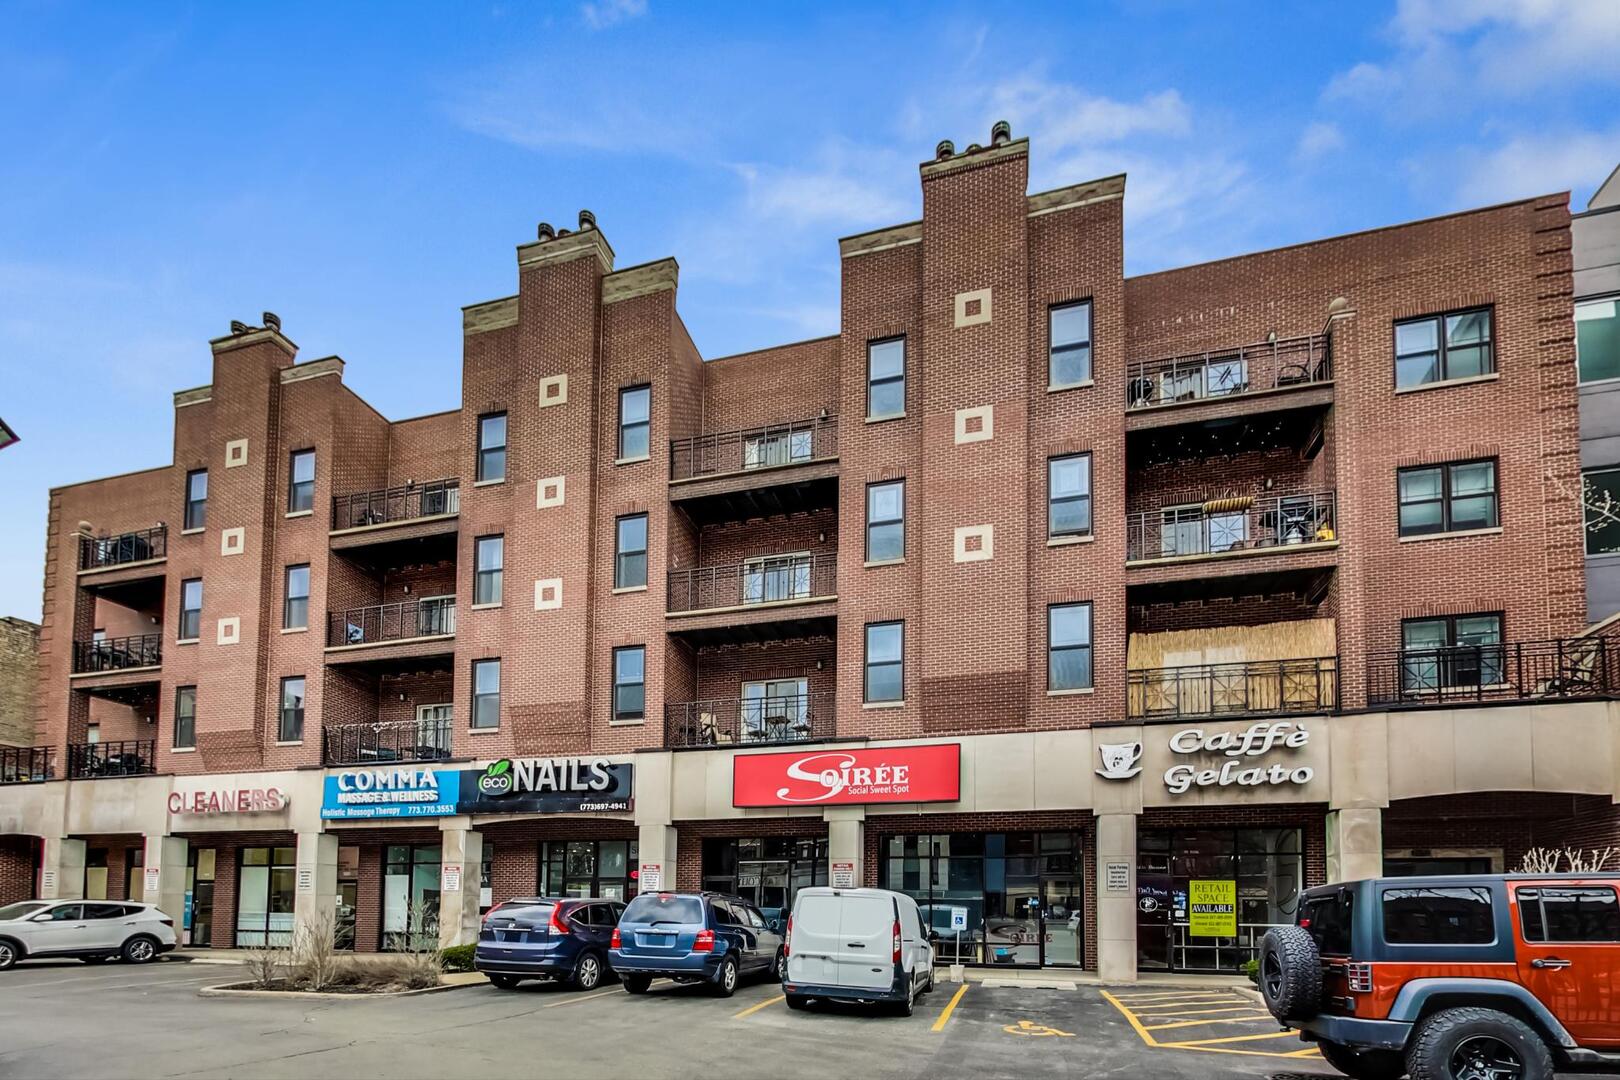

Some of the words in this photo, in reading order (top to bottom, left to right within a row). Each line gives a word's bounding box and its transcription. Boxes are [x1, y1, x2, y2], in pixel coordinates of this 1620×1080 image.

[1168, 721, 1310, 757] Caffè
[337, 767, 439, 792] COMMA
[512, 758, 611, 792] NAILS
[1163, 760, 1314, 794] Gelato
[482, 777, 509, 788] eco
[848, 786, 869, 795] Social
[870, 785, 891, 794] Sweet
[893, 784, 910, 795] Spot
[167, 787, 282, 814] CLEANERS
[322, 807, 346, 817] Holistic
[347, 806, 374, 818] Massage
[375, 806, 401, 817] Therapy
[407, 804, 455, 815] 773.770.3553
[1194, 883, 1231, 893] RETAIL
[1197, 893, 1229, 903] SPACE
[1192, 904, 1233, 913] AVAILABLE
